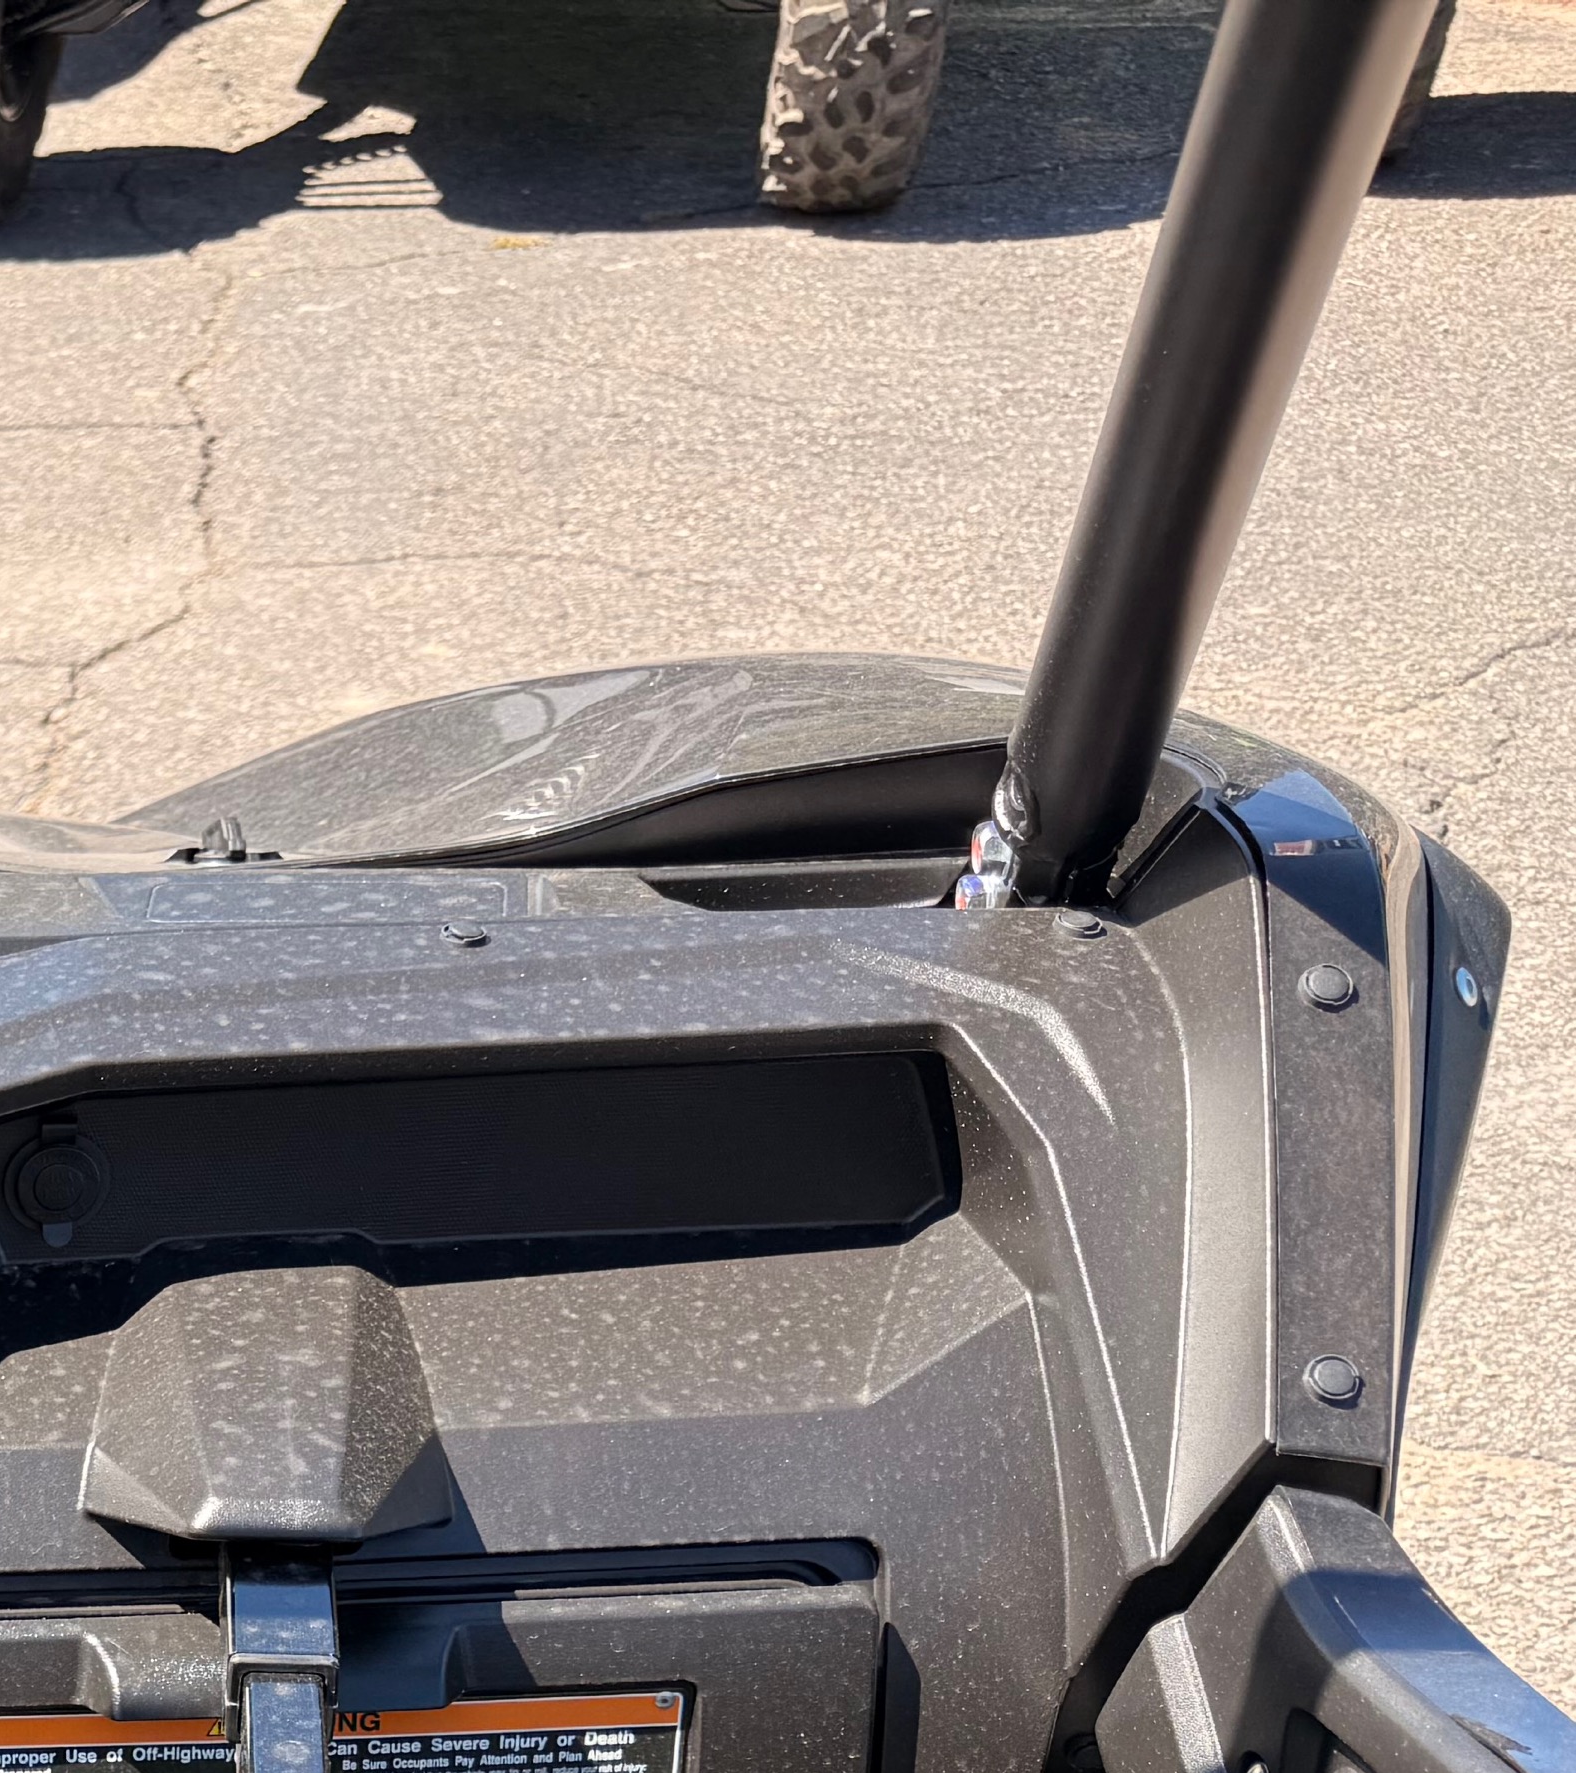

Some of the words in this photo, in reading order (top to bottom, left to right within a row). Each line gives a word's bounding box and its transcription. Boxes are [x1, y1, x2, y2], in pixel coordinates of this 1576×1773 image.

[328, 1742, 357, 1756] Can
[367, 1740, 421, 1754] Cause
[431, 1737, 490, 1752] Severe
[499, 1734, 547, 1751] Injury
[556, 1735, 575, 1747] or
[584, 1730, 635, 1746] Death
[66, 1749, 97, 1764] Use
[106, 1748, 123, 1763] of
[132, 1745, 234, 1764] Off-Highway
[342, 1760, 357, 1770] Be
[362, 1759, 387, 1770] Sure
[393, 1757, 449, 1770] Occupants
[454, 1755, 474, 1768] Pay
[479, 1753, 527, 1766] Attention
[533, 1752, 553, 1763] and
[558, 1751, 582, 1762] Plan
[587, 1748, 623, 1761] Ahead
